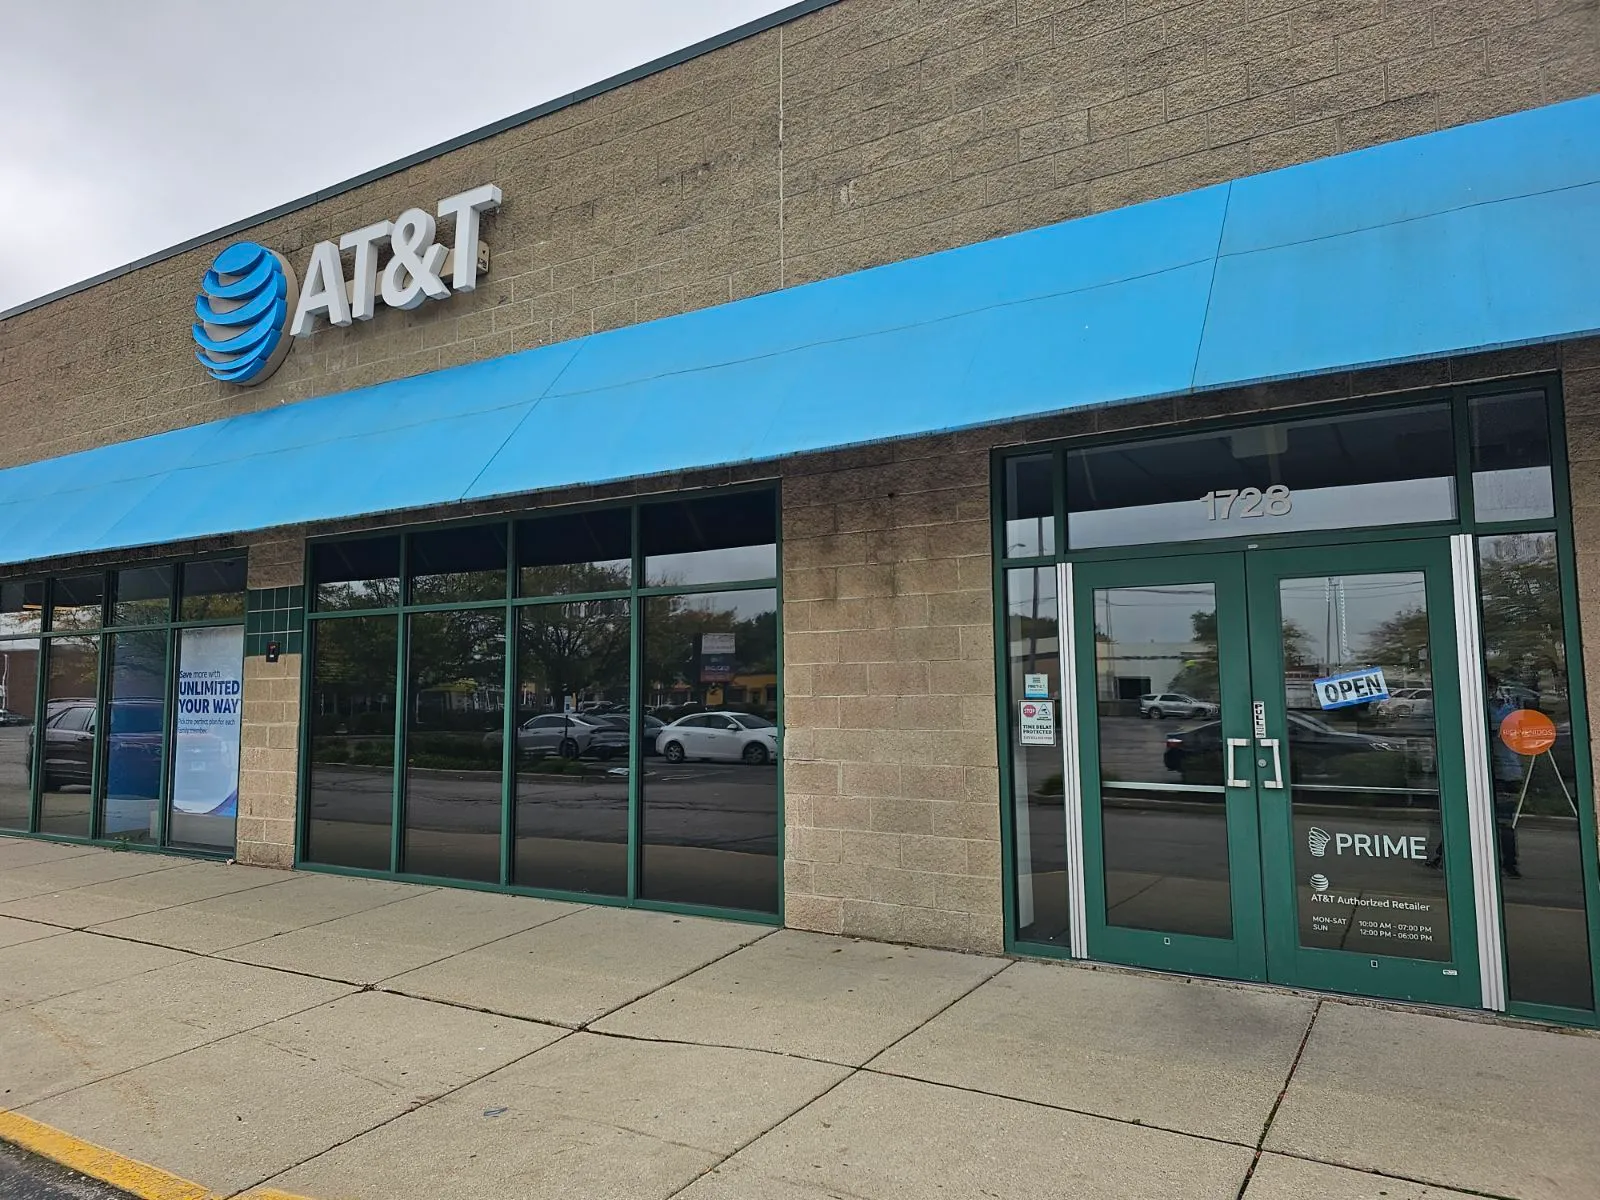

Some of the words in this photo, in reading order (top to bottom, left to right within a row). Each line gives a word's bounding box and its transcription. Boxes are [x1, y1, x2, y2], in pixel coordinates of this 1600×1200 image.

[290, 184, 502, 338] AT&T
[1200, 485, 1292, 520] 1728
[180, 670, 192, 678] Save
[209, 670, 220, 678] with
[180, 680, 240, 695] UNLIMITED
[1325, 674, 1383, 702] OPEN
[179, 699, 209, 713] YOUR
[213, 699, 239, 713] WAY
[1255, 704, 1263, 726] PULL
[1335, 833, 1427, 860] PRIME
[1311, 894, 1335, 903] AT&T
[1337, 896, 1389, 908] Authorized
[1392, 900, 1430, 911] Retailer
[1312, 916, 1346, 925] MON-SAT
[1380, 930, 1392, 938] PM
[1420, 934, 1433, 942] PM
